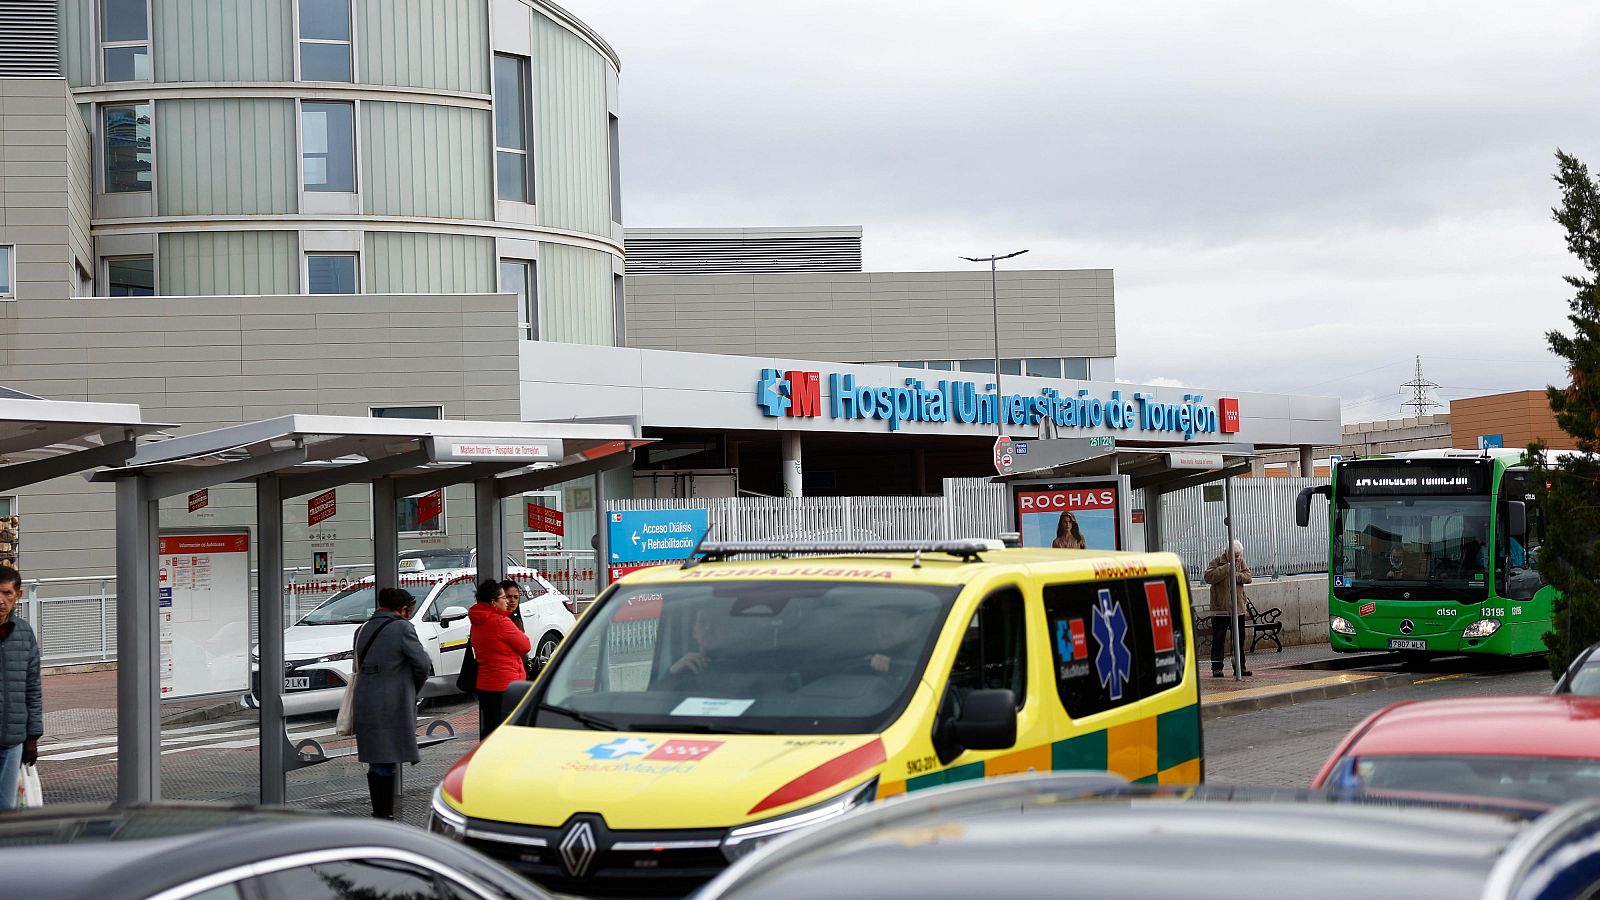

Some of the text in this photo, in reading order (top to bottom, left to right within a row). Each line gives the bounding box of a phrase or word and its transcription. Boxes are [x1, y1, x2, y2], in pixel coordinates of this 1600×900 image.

[830, 373, 949, 431] Hospital
[952, 381, 1102, 428] Universitario
[1104, 391, 1136, 429] de
[1134, 392, 1216, 440] Torrejón
[1090, 436, 1112, 446] 251 224
[460, 446, 475, 454] Mateo
[495, 446, 513, 456] Hospital
[514, 446, 521, 455] de
[521, 446, 540, 456] Torrejón
[1021, 491, 1113, 509] ROCHAS
[642, 521, 692, 534] Acceso Diálisis
[641, 537, 693, 552] y Rehabilitación
[1436, 608, 1457, 616] alsa
[1481, 607, 1505, 617] 13195
[1392, 640, 1410, 648] 7907
